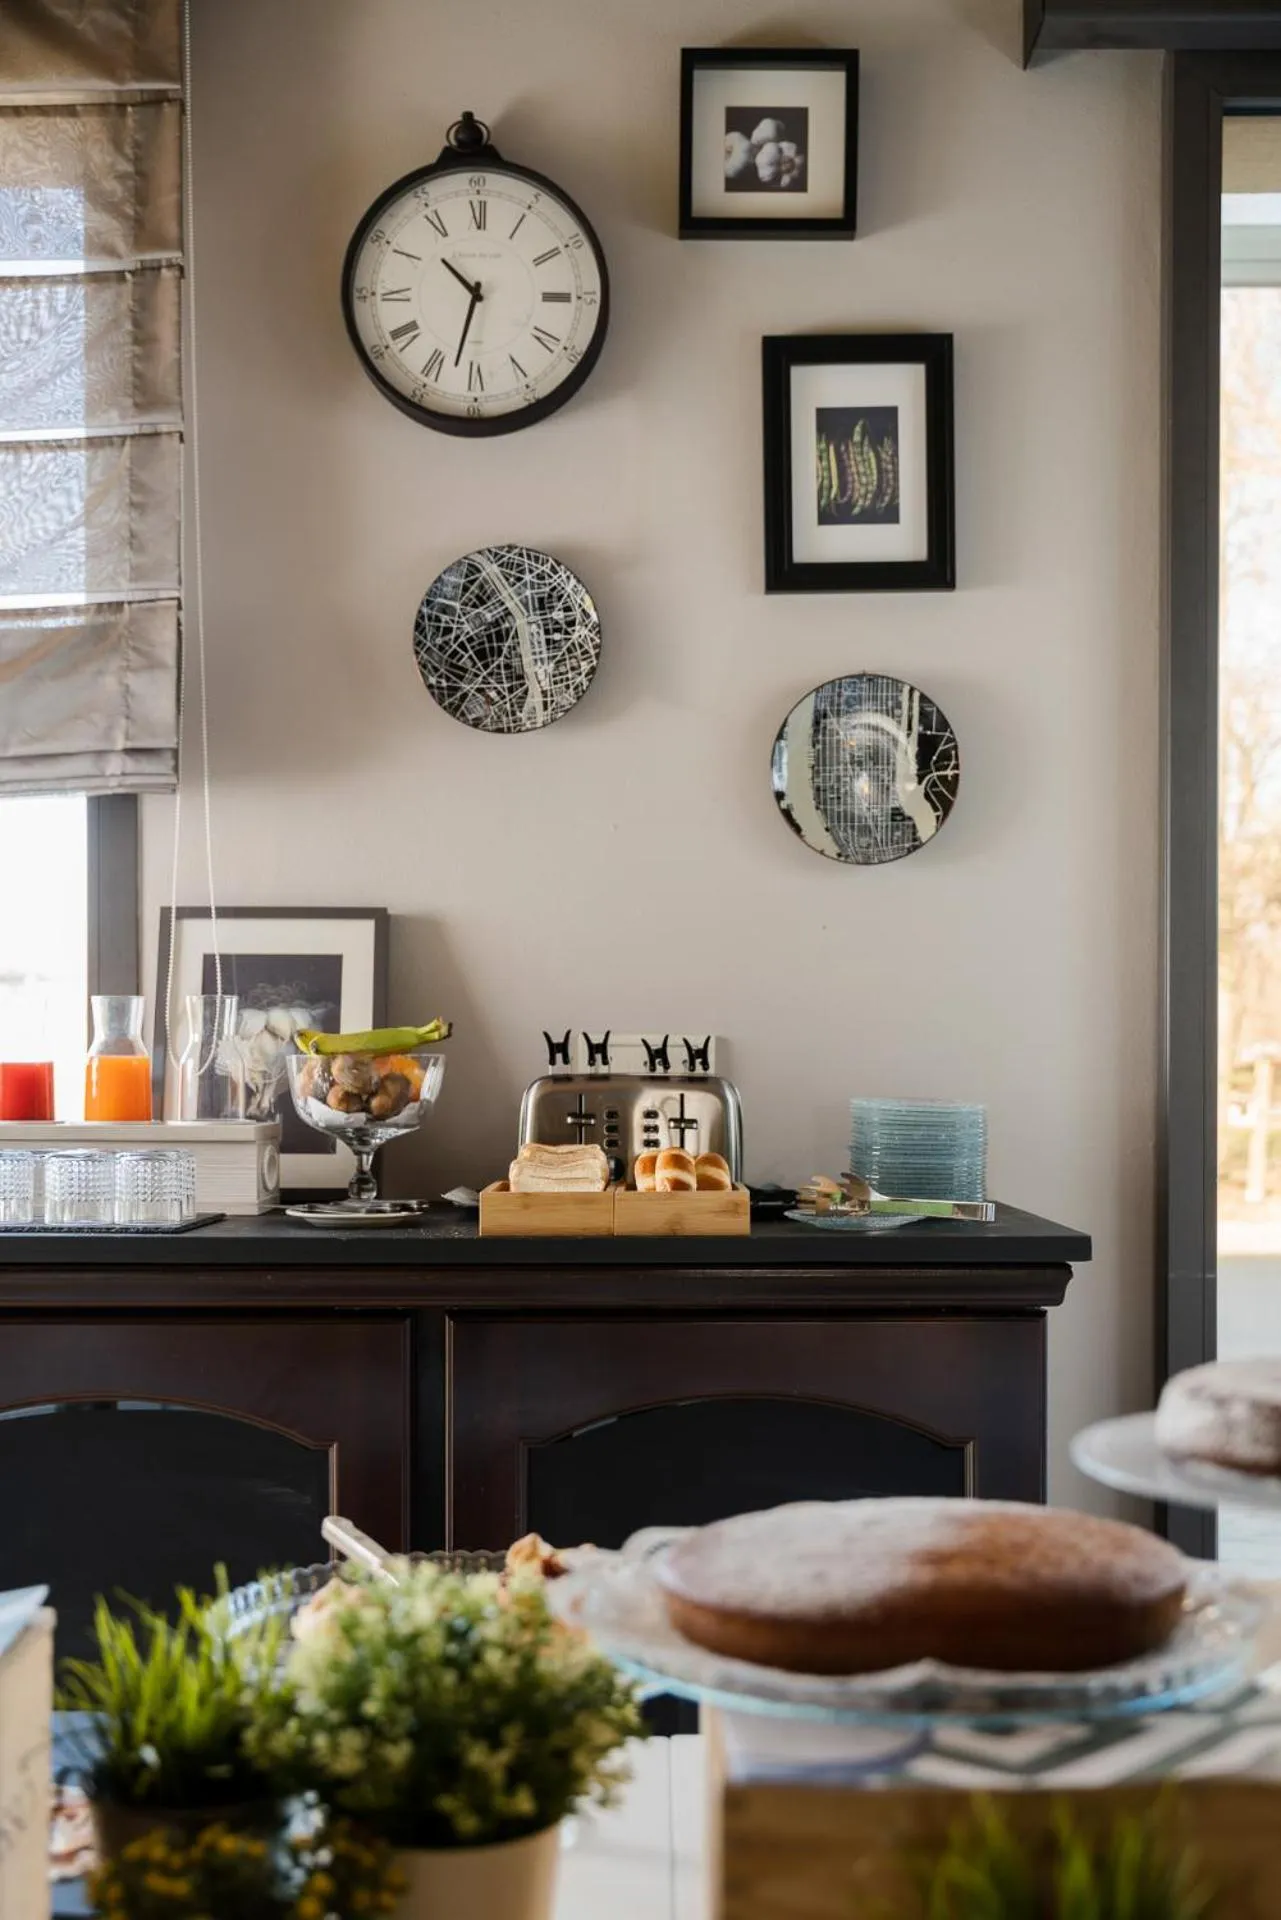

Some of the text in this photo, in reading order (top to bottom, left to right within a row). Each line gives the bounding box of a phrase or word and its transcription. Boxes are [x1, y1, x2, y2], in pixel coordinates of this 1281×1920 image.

[469, 176, 486, 188] 60
[532, 192, 542, 204] 5
[468, 200, 486, 230] XII
[370, 230, 386, 245] 50
[570, 231, 585, 250] 10
[533, 248, 561, 266] II
[355, 286, 368, 303] 45
[542, 292, 571, 303] III
[584, 291, 596, 306] 15
[370, 344, 385, 360] 40
